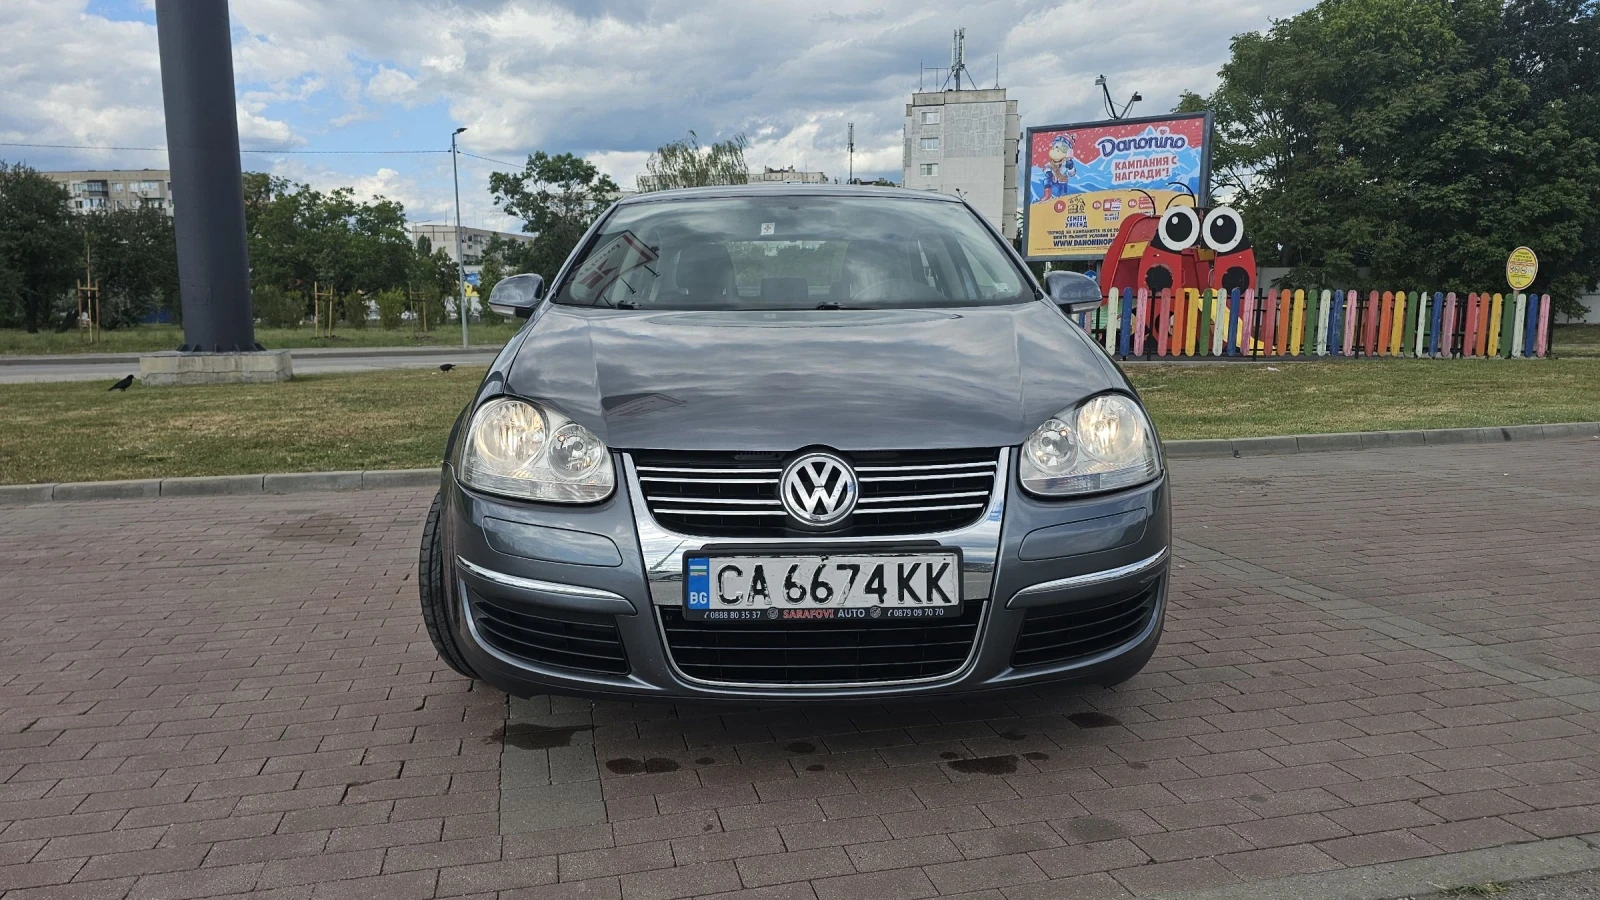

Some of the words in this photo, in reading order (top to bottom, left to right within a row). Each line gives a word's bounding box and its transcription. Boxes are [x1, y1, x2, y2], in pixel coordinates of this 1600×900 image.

[1097, 136, 1186, 158] Danonino
[1114, 156, 1169, 171] КАМПАНИЯ
[1053, 238, 1116, 247] WWW.DANONINOP
[690, 592, 708, 604] BG
[782, 563, 888, 605] 6674
[710, 611, 728, 619] 0888
[730, 611, 740, 619] 80
[782, 609, 834, 619] SARAFOVI
[837, 609, 865, 618] AUTO
[893, 609, 912, 617] 0879
[913, 608, 922, 616] 09
[924, 608, 933, 616] 70
[935, 608, 944, 616] 70
